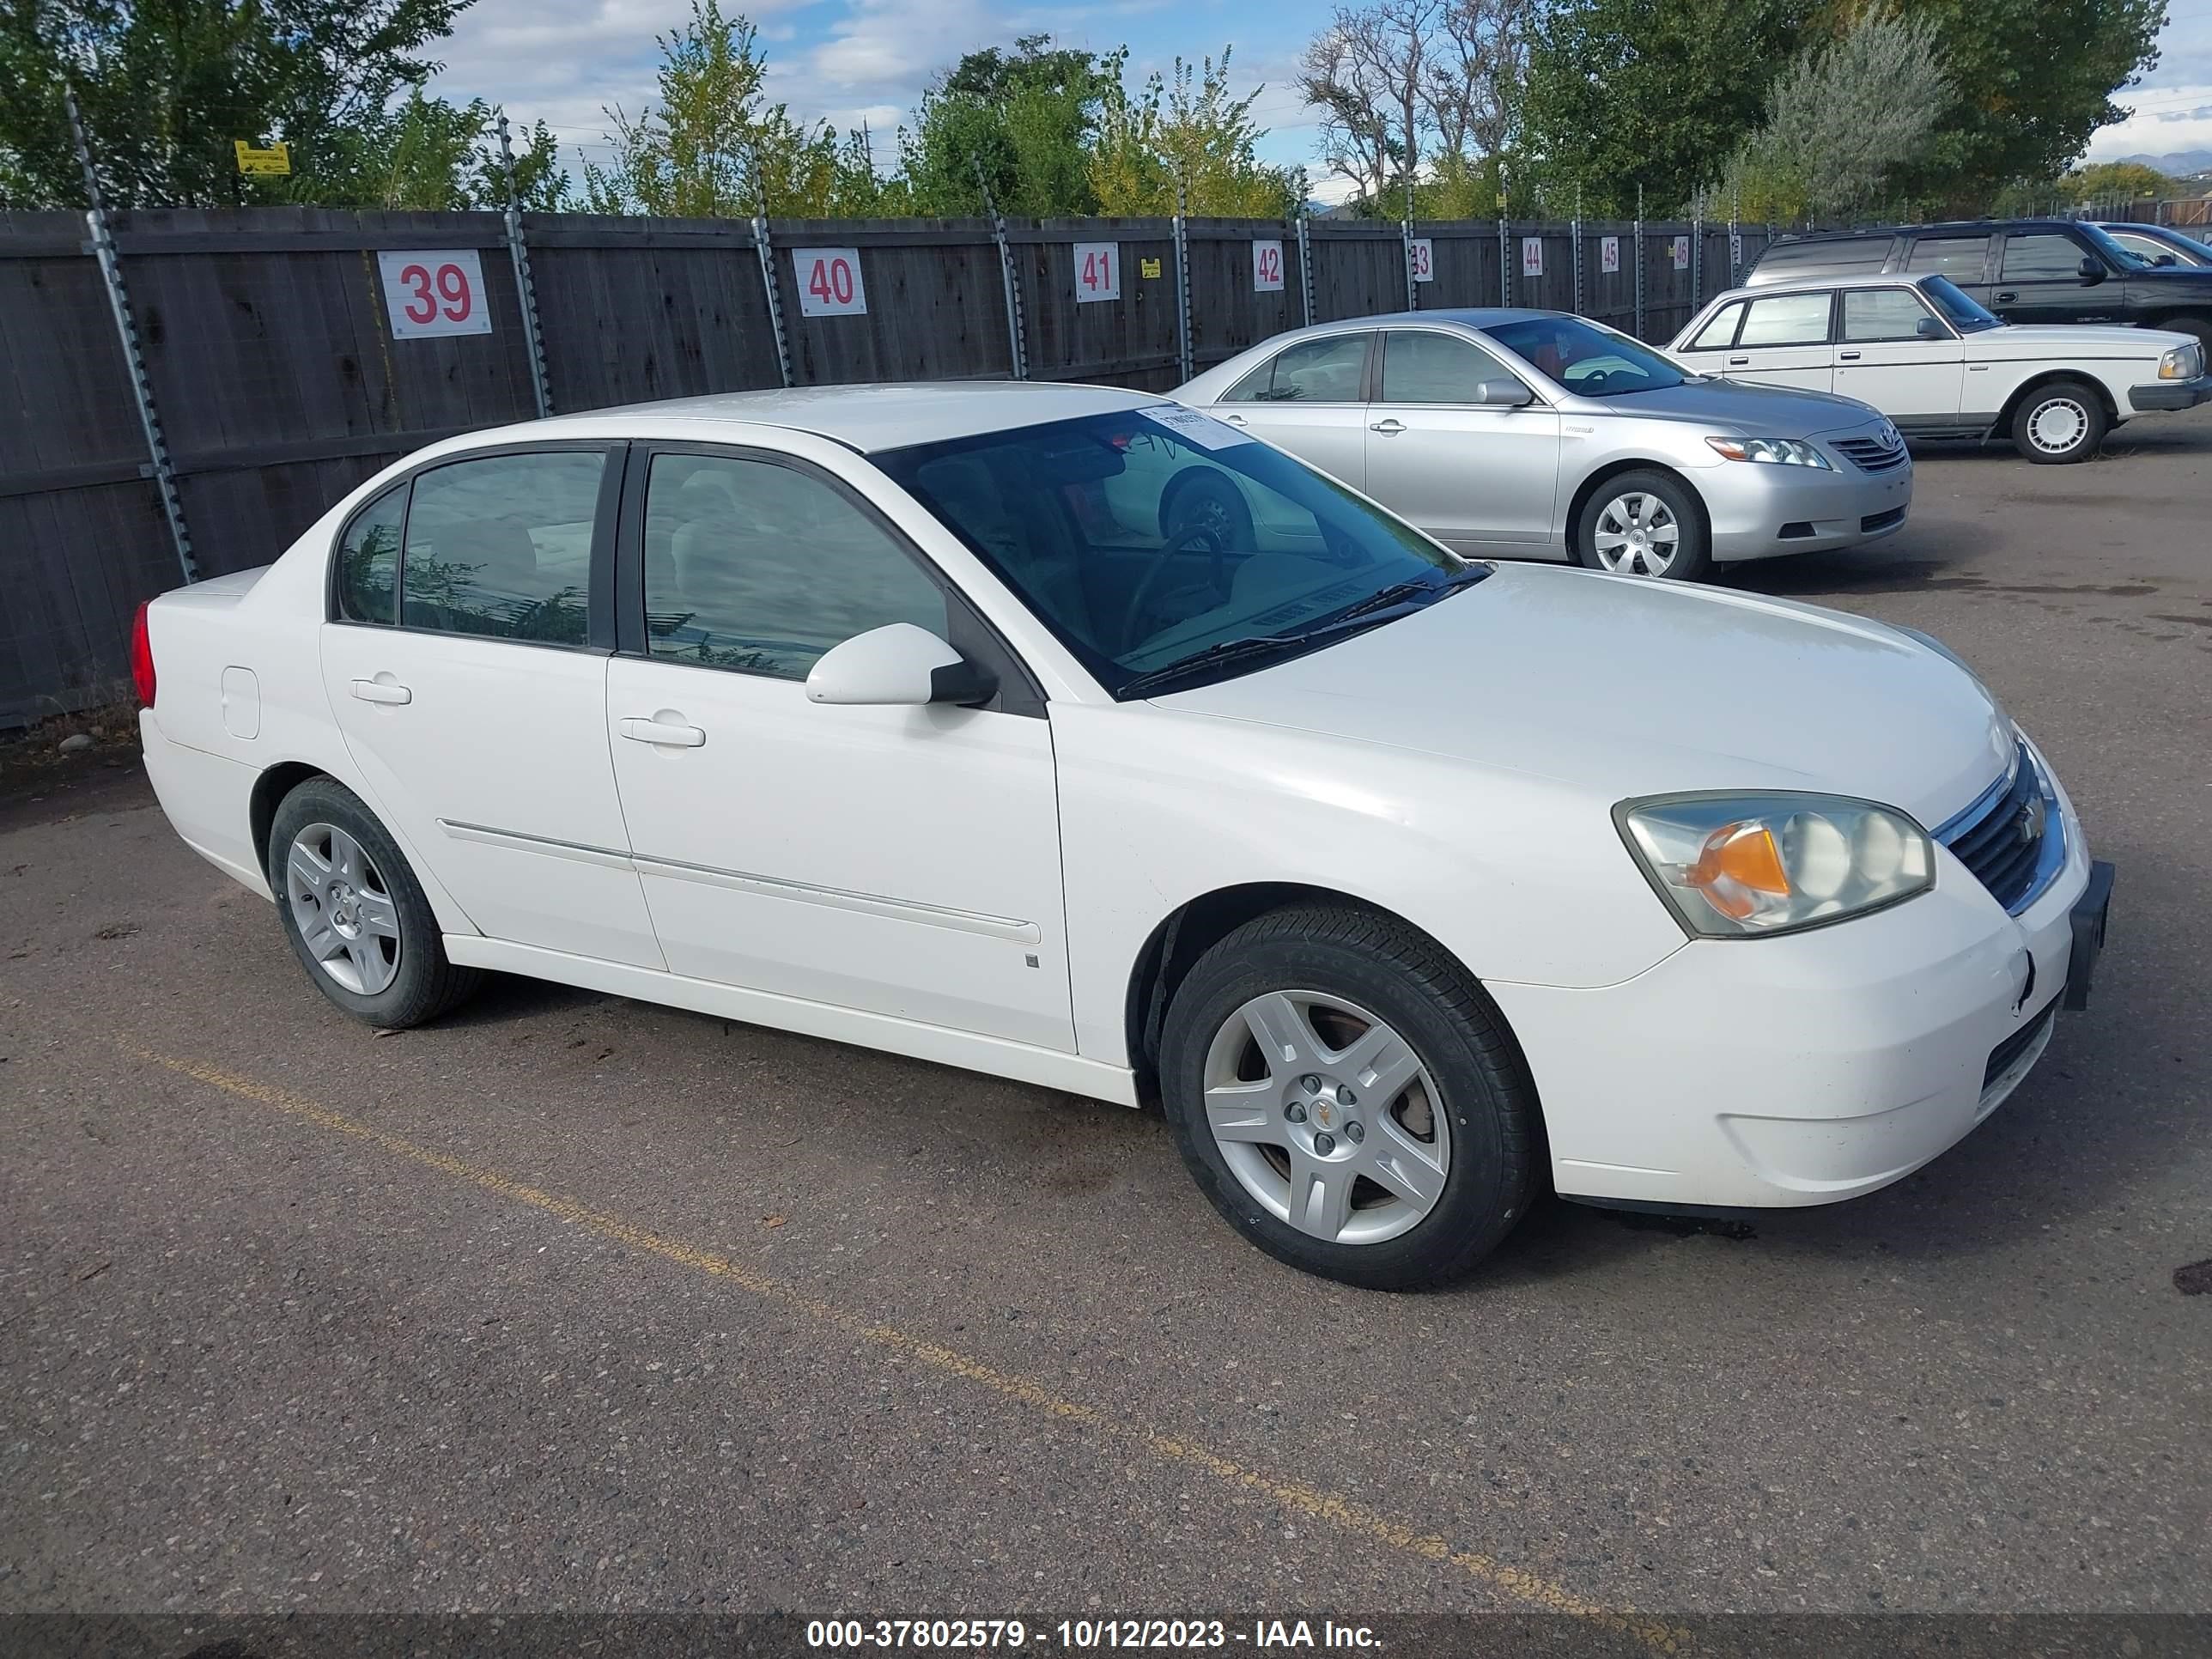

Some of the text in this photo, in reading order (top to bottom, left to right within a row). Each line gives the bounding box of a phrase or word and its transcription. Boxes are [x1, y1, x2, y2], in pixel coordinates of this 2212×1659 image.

[1259, 248, 1279, 282] 42
[1526, 243, 1540, 270] 44
[1604, 242, 1616, 266] 45
[1676, 241, 1687, 264] 46
[810, 258, 854, 304] 40
[1083, 251, 1110, 291] 41
[400, 264, 471, 325] 39
